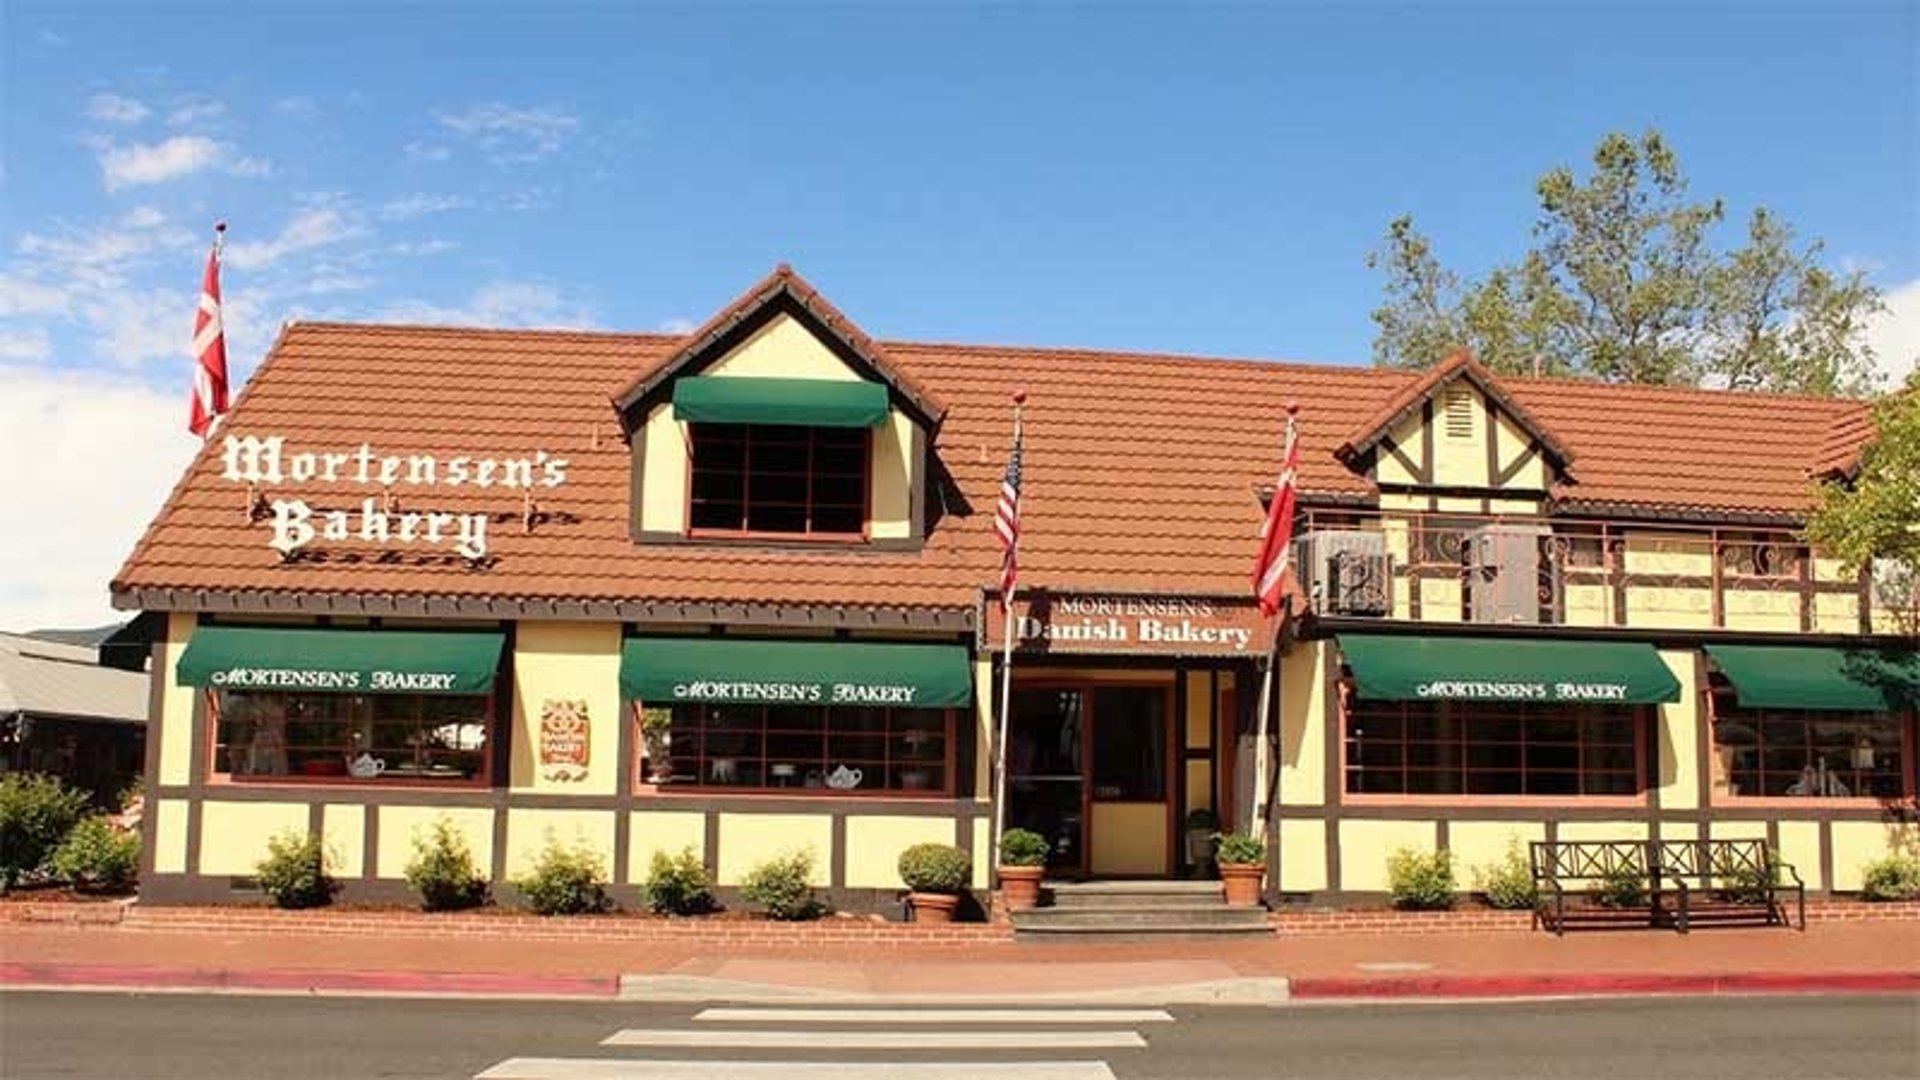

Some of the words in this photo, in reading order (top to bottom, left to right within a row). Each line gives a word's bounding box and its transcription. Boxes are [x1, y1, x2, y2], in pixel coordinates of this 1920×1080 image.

[221, 433, 569, 487] Mortensen's
[268, 498, 488, 558] Bakery
[1017, 615, 1127, 641] Danish
[1138, 618, 1252, 648] Bakery
[212, 668, 359, 688] MORTENSEN'S
[370, 671, 456, 689] BAKERY
[674, 681, 820, 702] MORTENSEN'S
[831, 685, 916, 702] BAKERY
[1417, 680, 1546, 698] MORTENSEN'S
[1556, 682, 1627, 699] BAKERY
